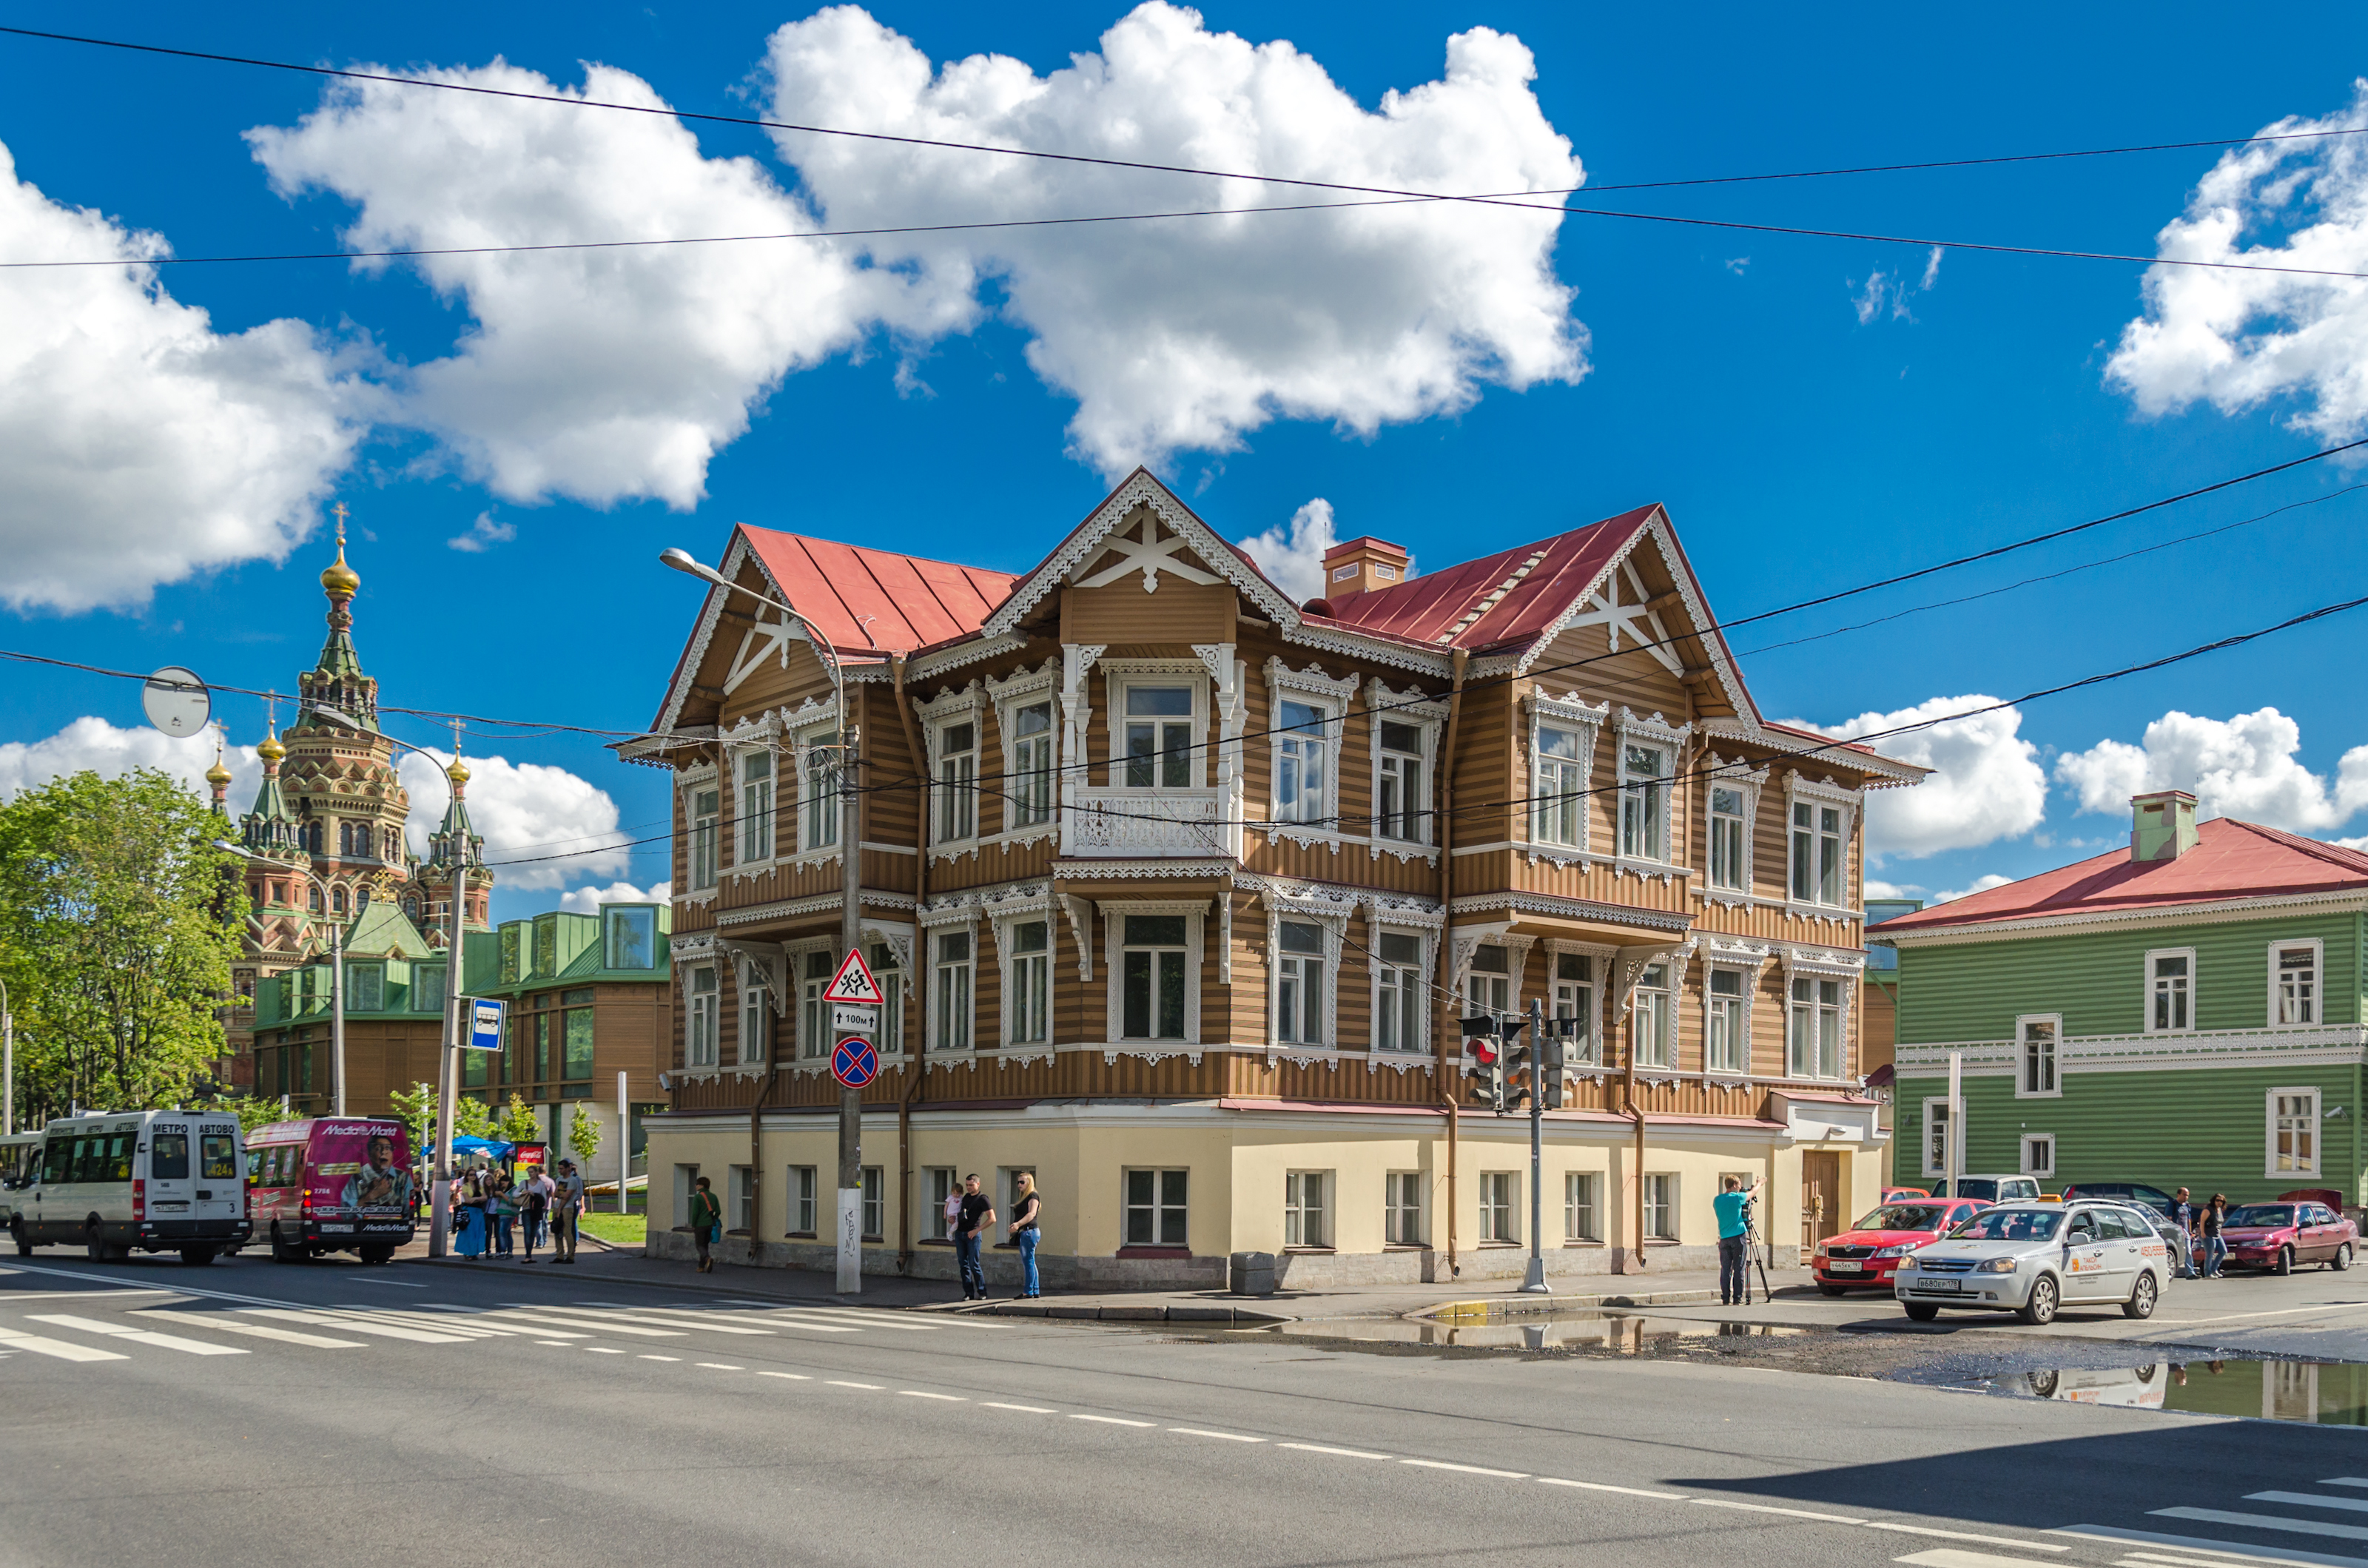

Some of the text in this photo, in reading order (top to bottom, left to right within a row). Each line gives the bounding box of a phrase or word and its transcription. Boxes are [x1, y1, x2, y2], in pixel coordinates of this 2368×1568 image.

[114, 1121, 139, 1131] АВТОВО
[152, 1124, 235, 1134] МЕТРО АВТОВО
[322, 1124, 358, 1135] Media
[366, 1125, 397, 1137] Markt
[229, 1202, 235, 1214] 3
[2141, 1245, 2167, 1256] 450-5555
